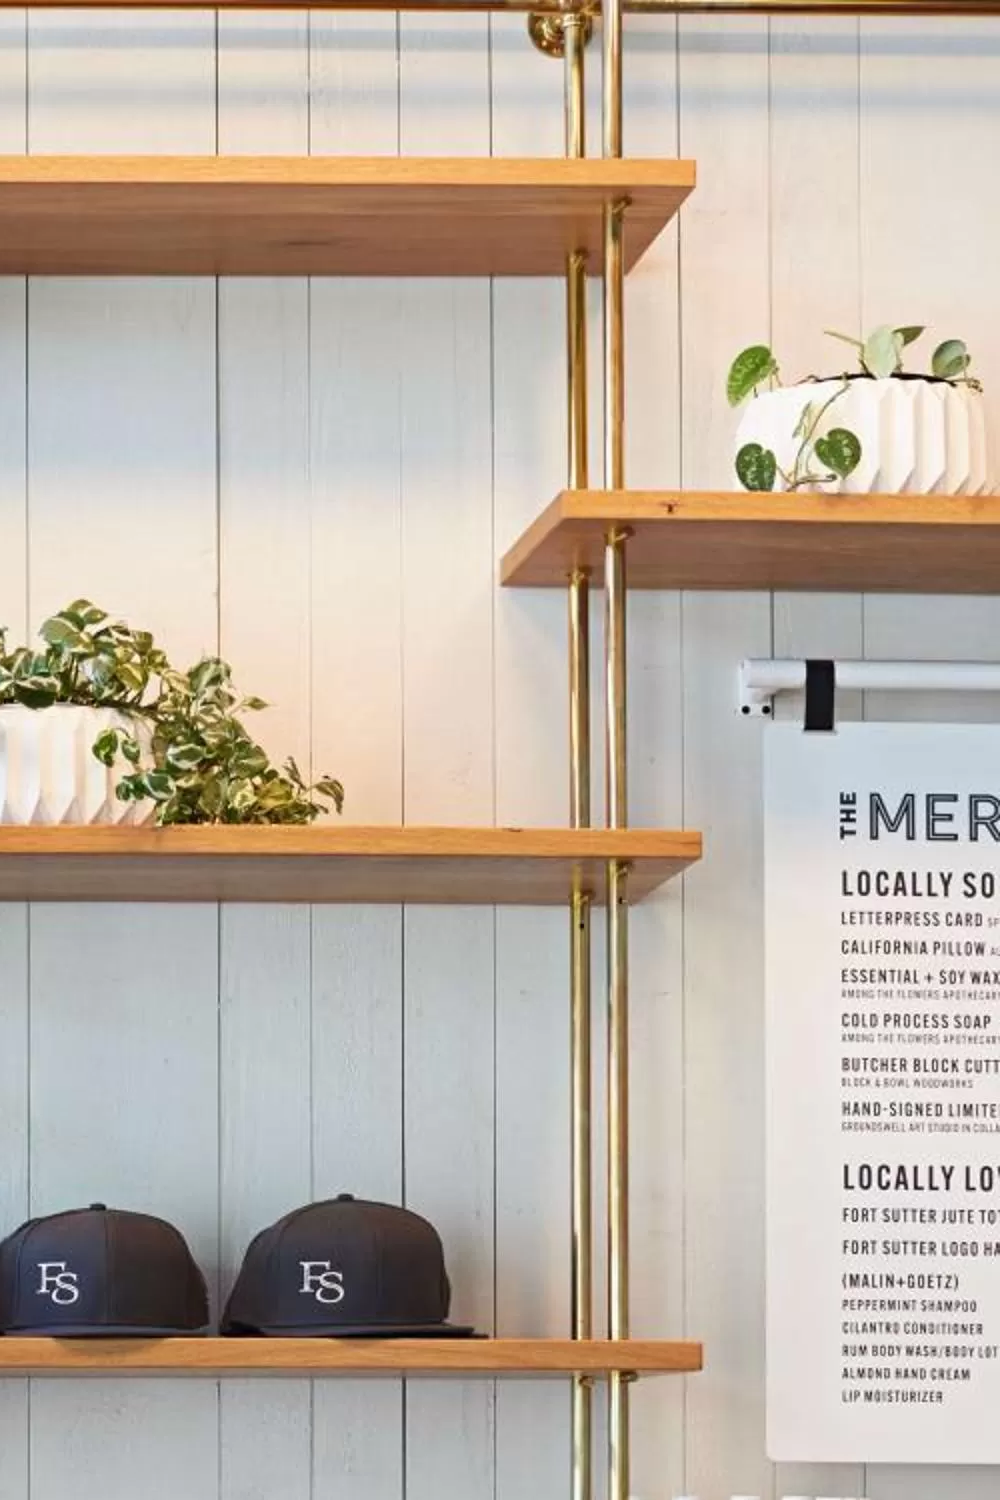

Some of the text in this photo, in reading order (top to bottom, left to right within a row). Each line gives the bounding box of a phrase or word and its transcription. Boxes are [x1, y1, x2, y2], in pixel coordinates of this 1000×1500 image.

[840, 791, 1000, 842] THE MER
[842, 869, 995, 899] LOCALLY SO
[841, 911, 940, 927] LETTERPRESS
[945, 911, 983, 927] CARD
[841, 939, 928, 955] CALIFORNIA
[933, 941, 986, 957] PILLOW
[841, 969, 919, 984] ESSENTIAL
[939, 969, 965, 985] SOY
[970, 970, 1000, 985] WAX
[841, 1013, 991, 1029] COLD PROCESS SOAP
[841, 1057, 1000, 1074] BUTCHER BLOCK CUTT
[841, 1101, 1000, 1118] HAND-SIGNED LIMITE
[843, 1163, 956, 1191] LOCALLY
[842, 1207, 1000, 1225] FORT SUTTER JUTE TO
[842, 1239, 877, 1255] FORT
[882, 1240, 936, 1255] SUTTER
[942, 1241, 979, 1257] LOGO
[36, 1261, 79, 1305] FS
[299, 1260, 345, 1304] FS
[842, 1273, 960, 1291] (MALIN+GOETZ)
[842, 1299, 977, 1313] PEPPERMINT SHAMPOO
[842, 1321, 983, 1335] CILANTRO CONDITIONER
[842, 1344, 868, 1357] RUM
[872, 1344, 901, 1357] BODY
[842, 1367, 971, 1381] ALMOND HAND CREAM
[842, 1389, 943, 1403] LIP MOISTURIZER
